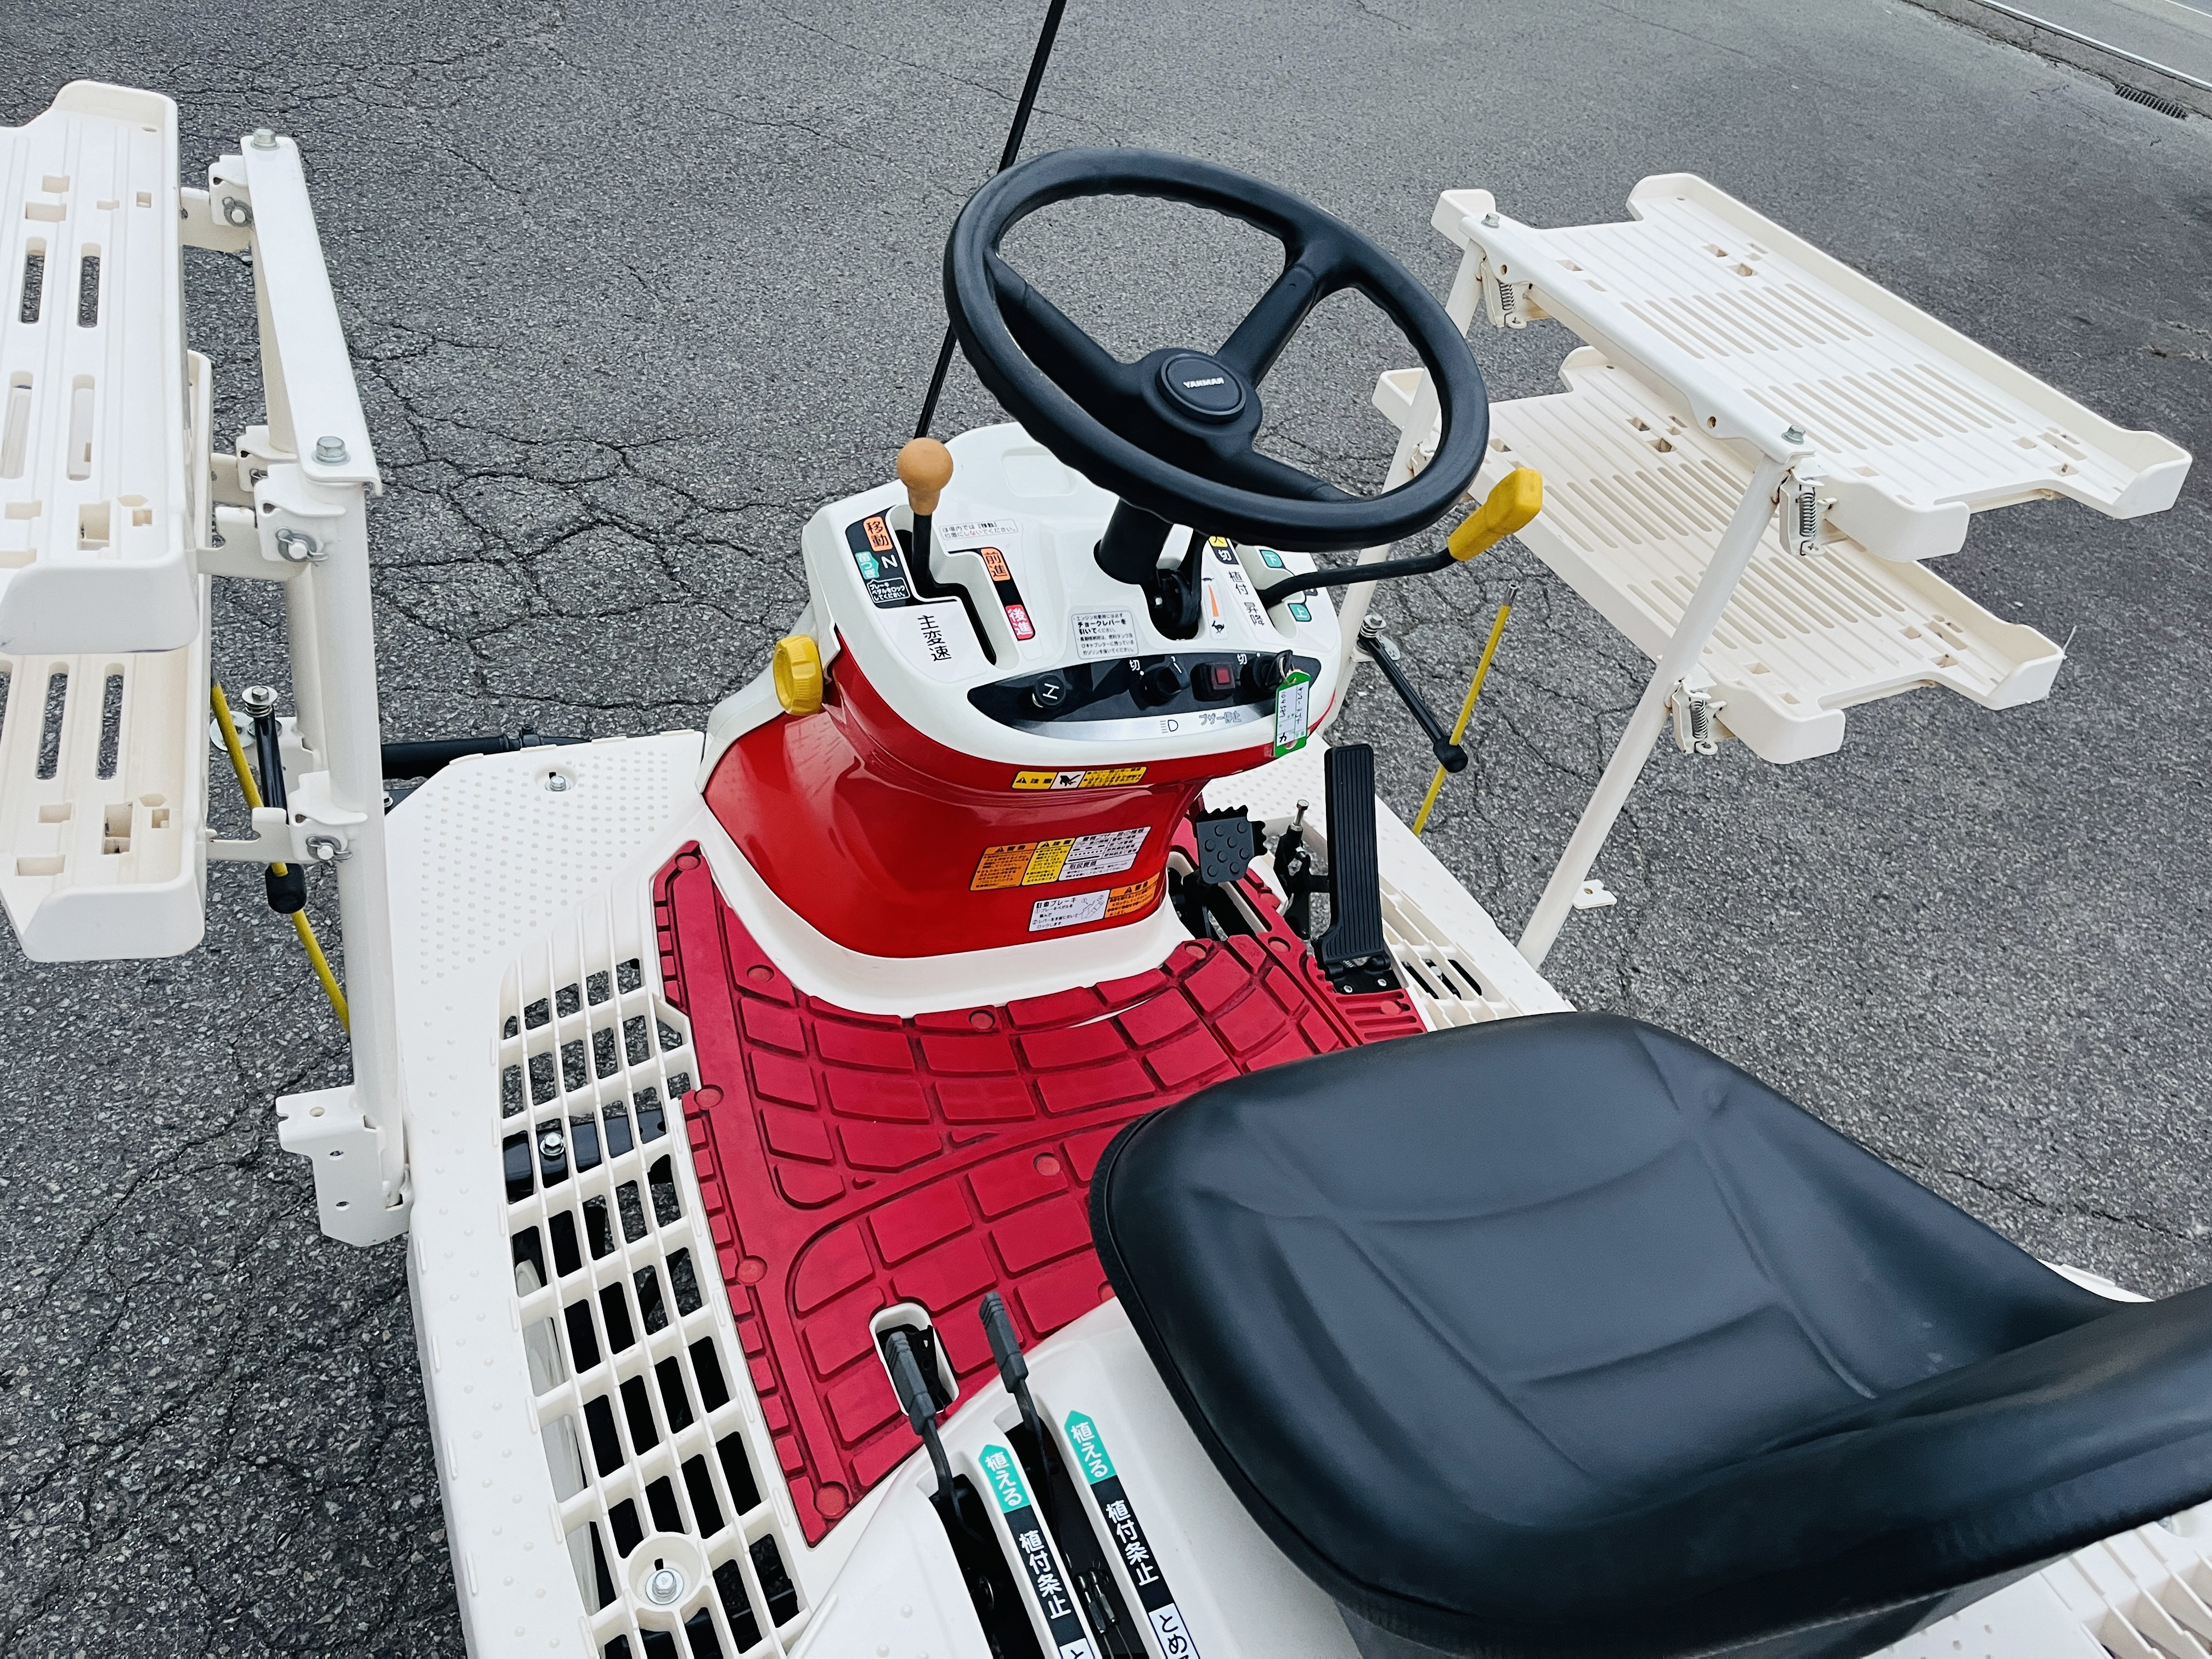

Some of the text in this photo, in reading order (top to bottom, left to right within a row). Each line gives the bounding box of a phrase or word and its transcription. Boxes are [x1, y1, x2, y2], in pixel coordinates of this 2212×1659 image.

[1183, 377, 1224, 389] YANMAR
[866, 521, 889, 548] 移動
[857, 552, 876, 578] 苗つぎ
[881, 554, 898, 569] N
[984, 551, 1008, 577] 前進
[1218, 549, 1232, 561] 切
[1265, 553, 1276, 564] 下
[1228, 571, 1249, 595] 植付
[1007, 607, 1033, 636] 後進
[1297, 607, 1307, 618] 上
[917, 615, 952, 662] 主変速
[1129, 659, 1141, 671] 切
[1237, 653, 1248, 665] 切
[1199, 710, 1242, 725] ブザー停止
[1070, 1421, 1108, 1478] 植える
[985, 1451, 1023, 1506] 植える
[1105, 1499, 1159, 1586] 植付条止
[1018, 1530, 1071, 1620] 植付条止
